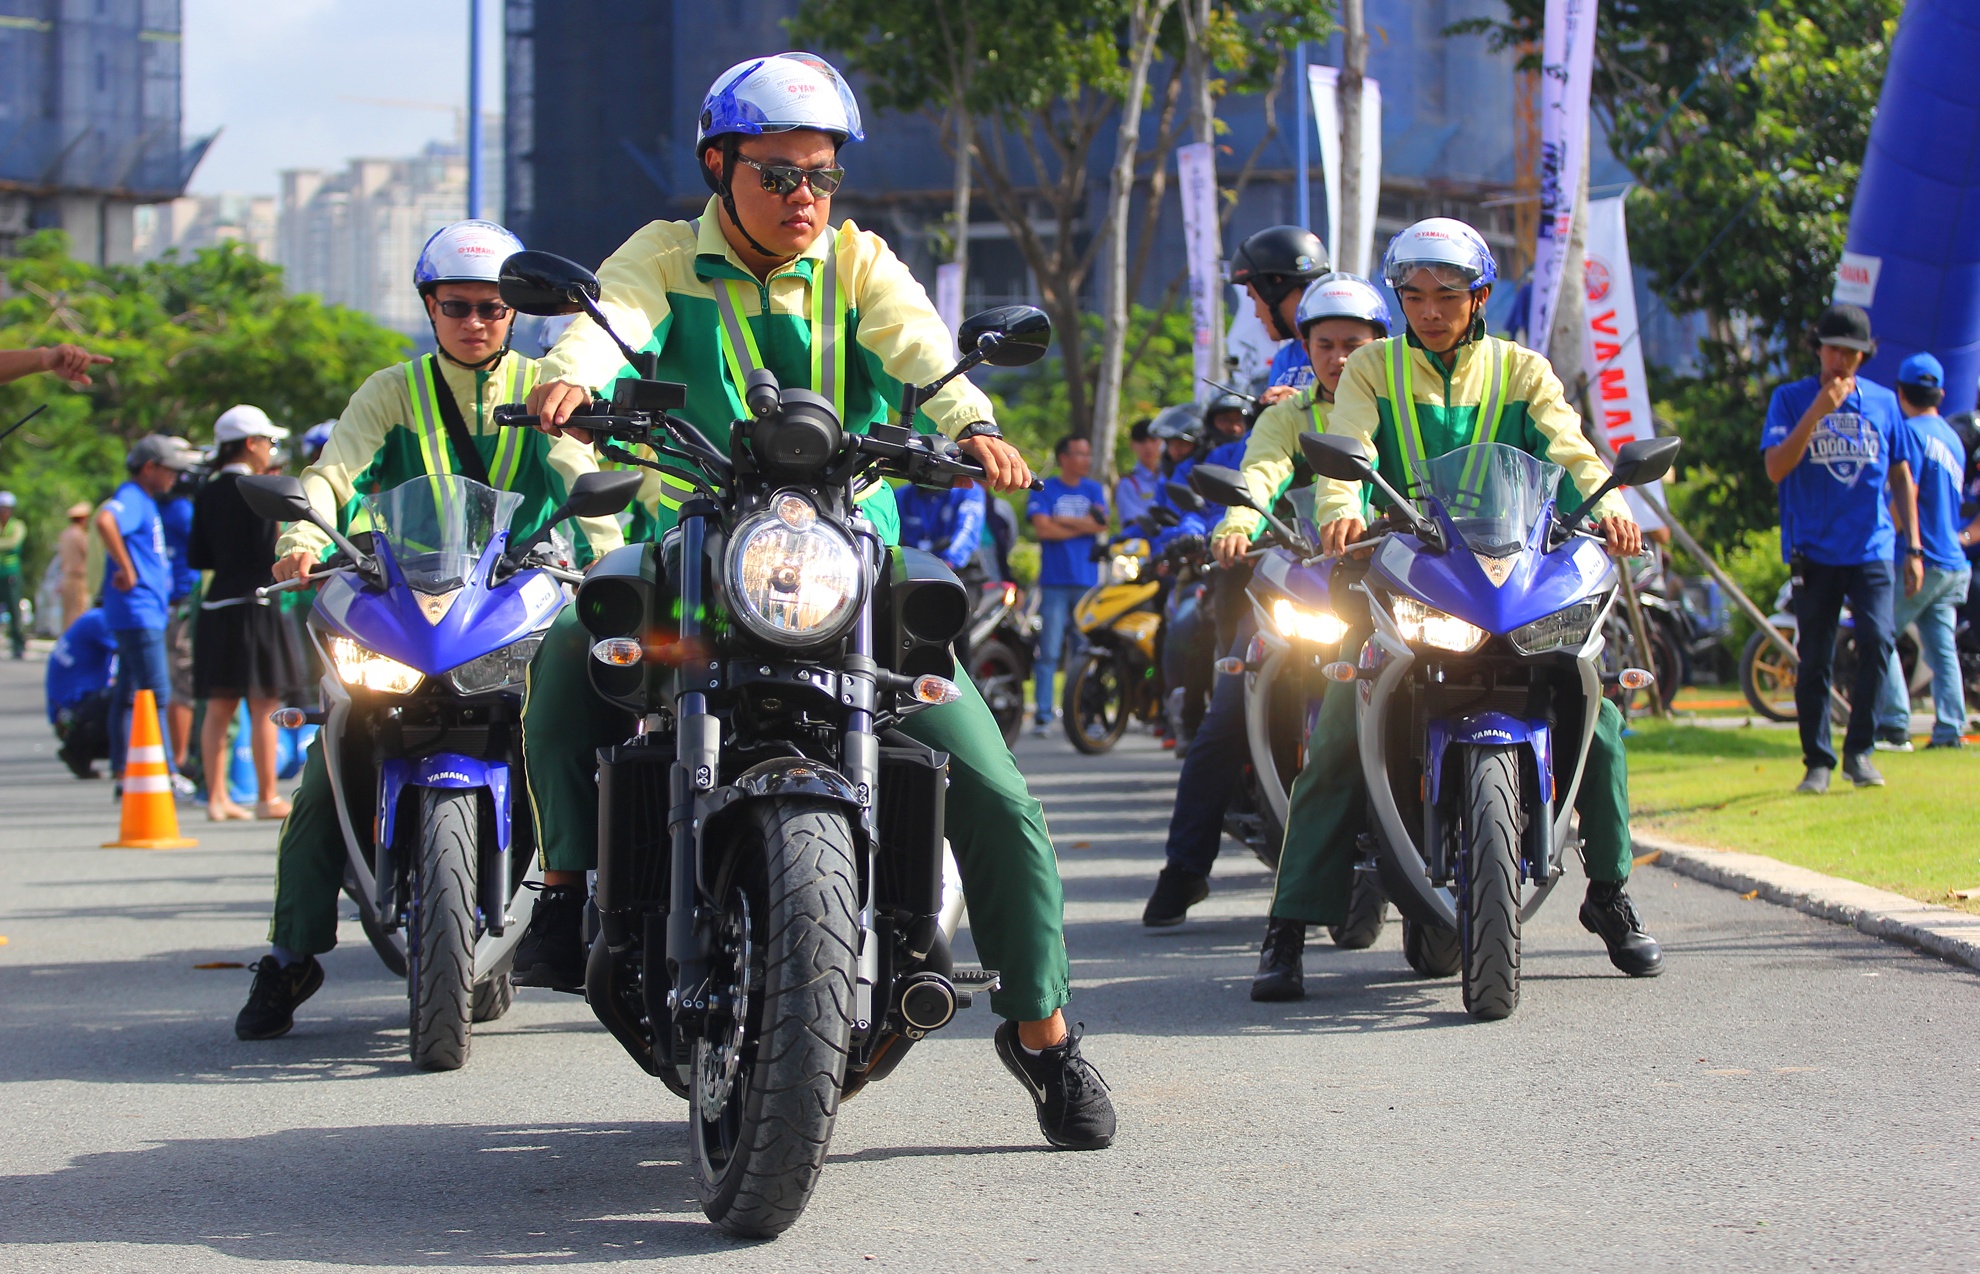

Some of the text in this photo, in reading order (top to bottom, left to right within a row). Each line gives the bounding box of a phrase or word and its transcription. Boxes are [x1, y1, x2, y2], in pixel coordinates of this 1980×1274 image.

[1421, 231, 1449, 239] YAMAHA
[465, 246, 496, 255] YAMAHA
[1471, 729, 1513, 740] YAMAHA
[427, 771, 470, 783] YAMAHA
